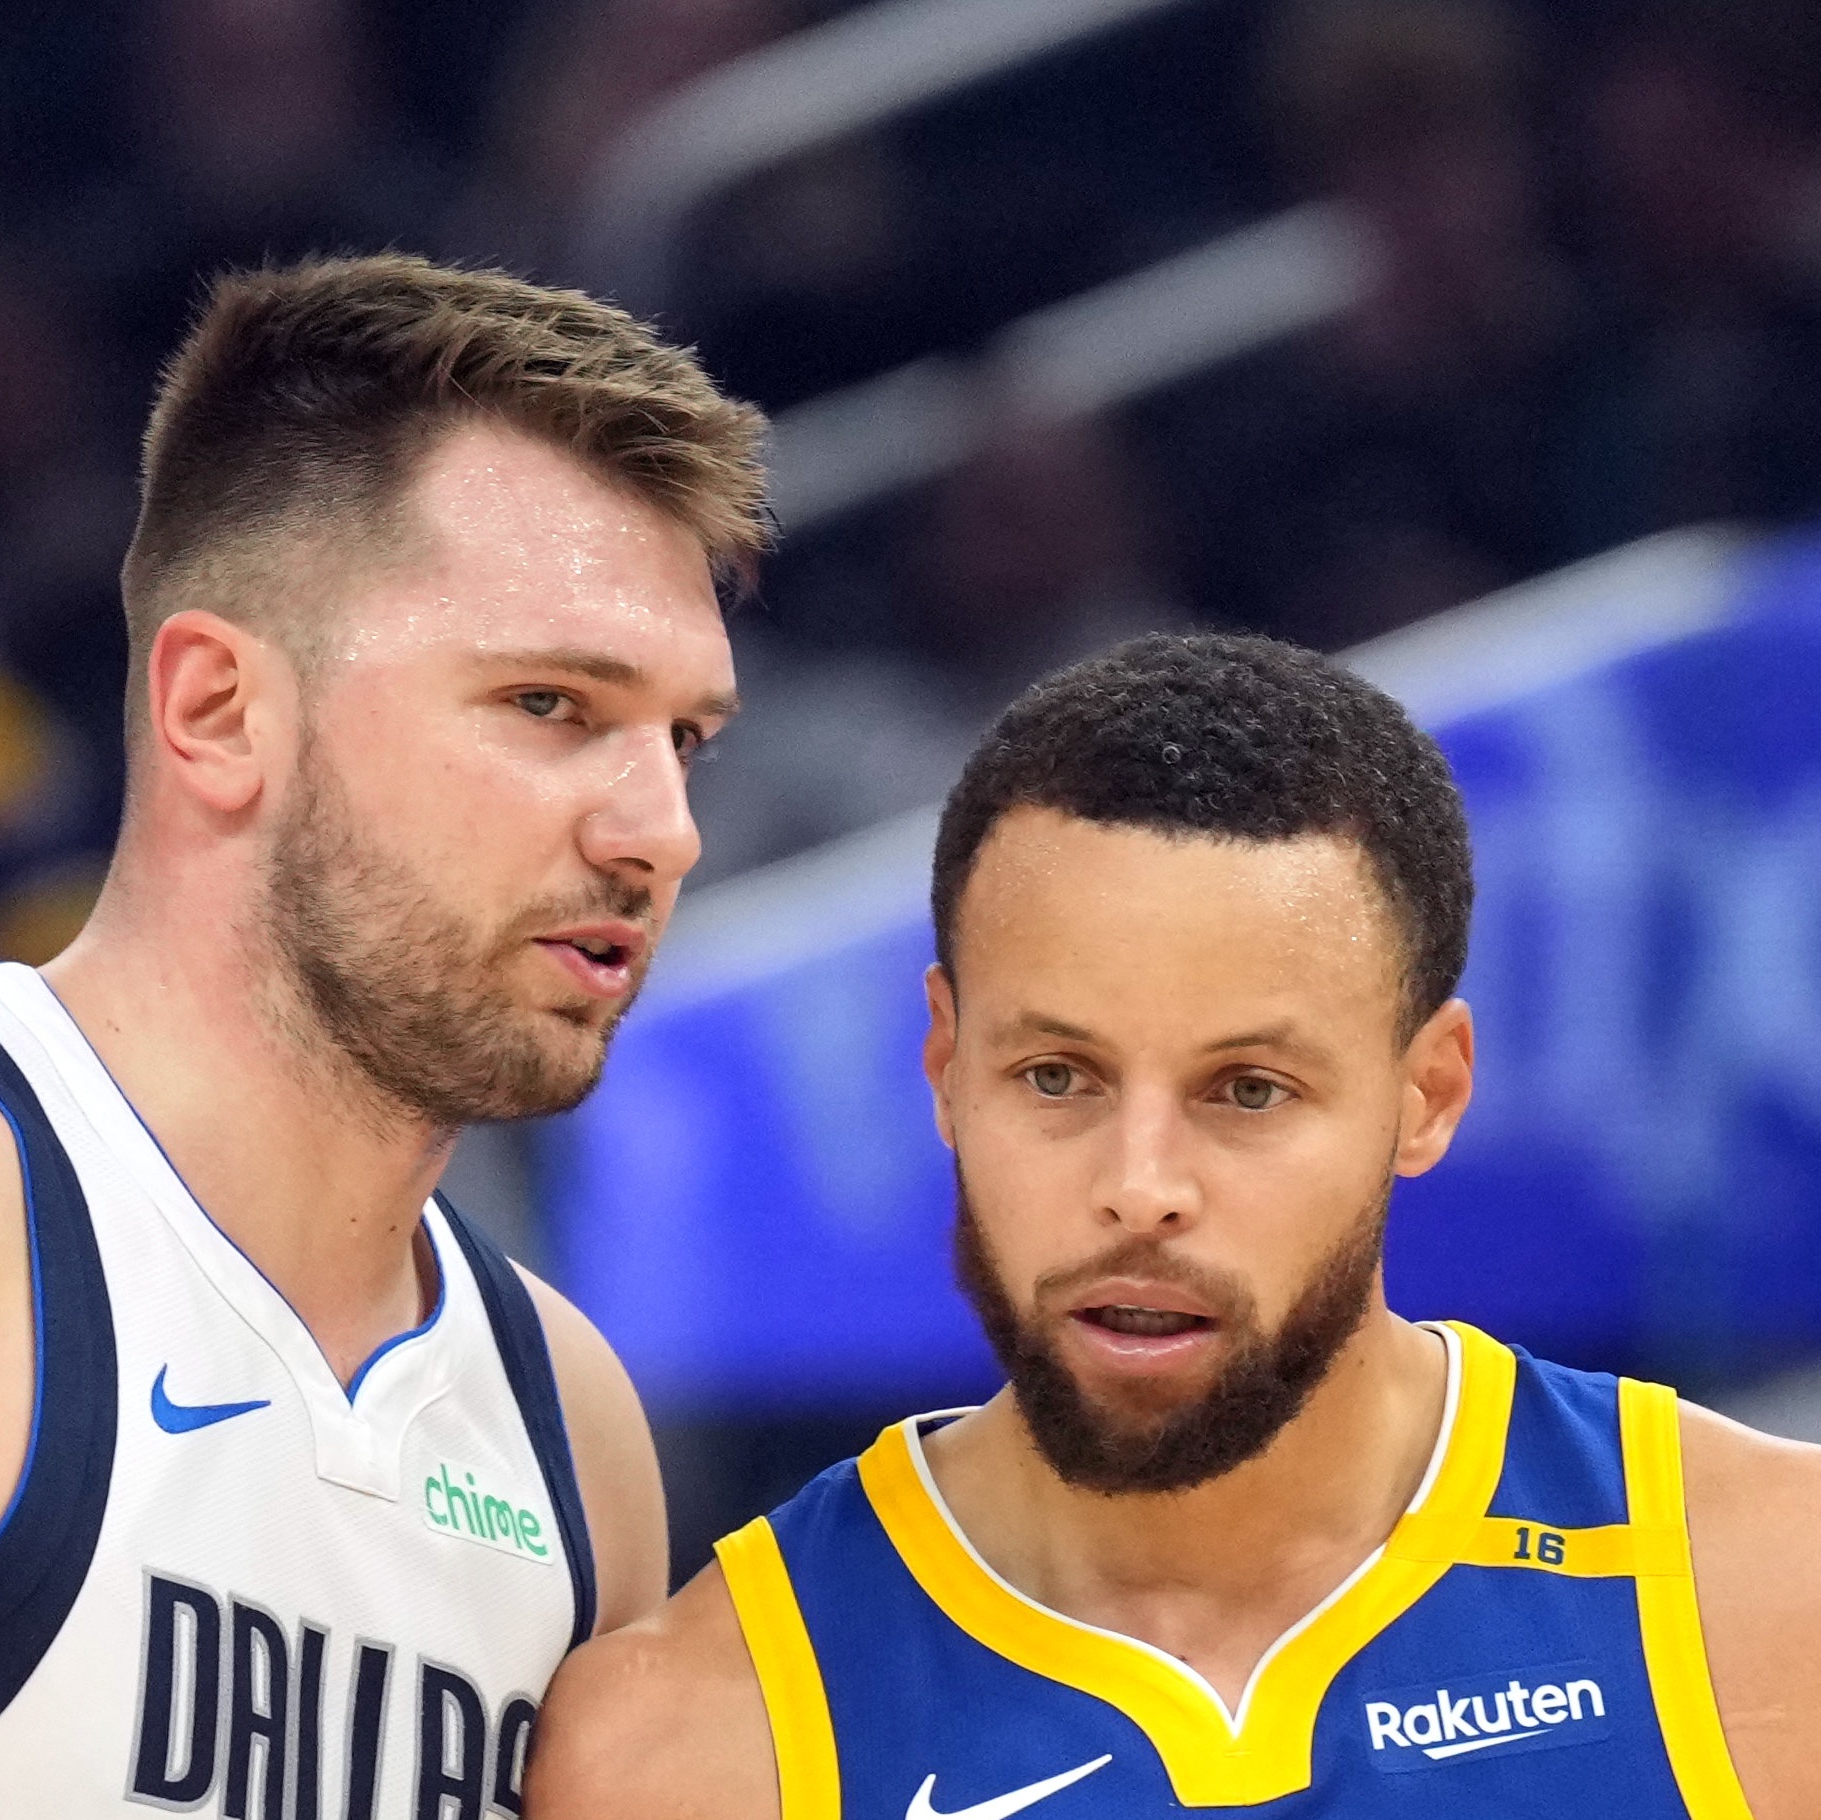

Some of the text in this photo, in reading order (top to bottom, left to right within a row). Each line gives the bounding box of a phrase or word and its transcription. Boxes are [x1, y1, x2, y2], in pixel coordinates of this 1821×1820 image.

[424, 1462, 549, 1557] chime
[1514, 1527, 1566, 1566] 16
[1366, 1678, 1605, 1753] Rakuten
